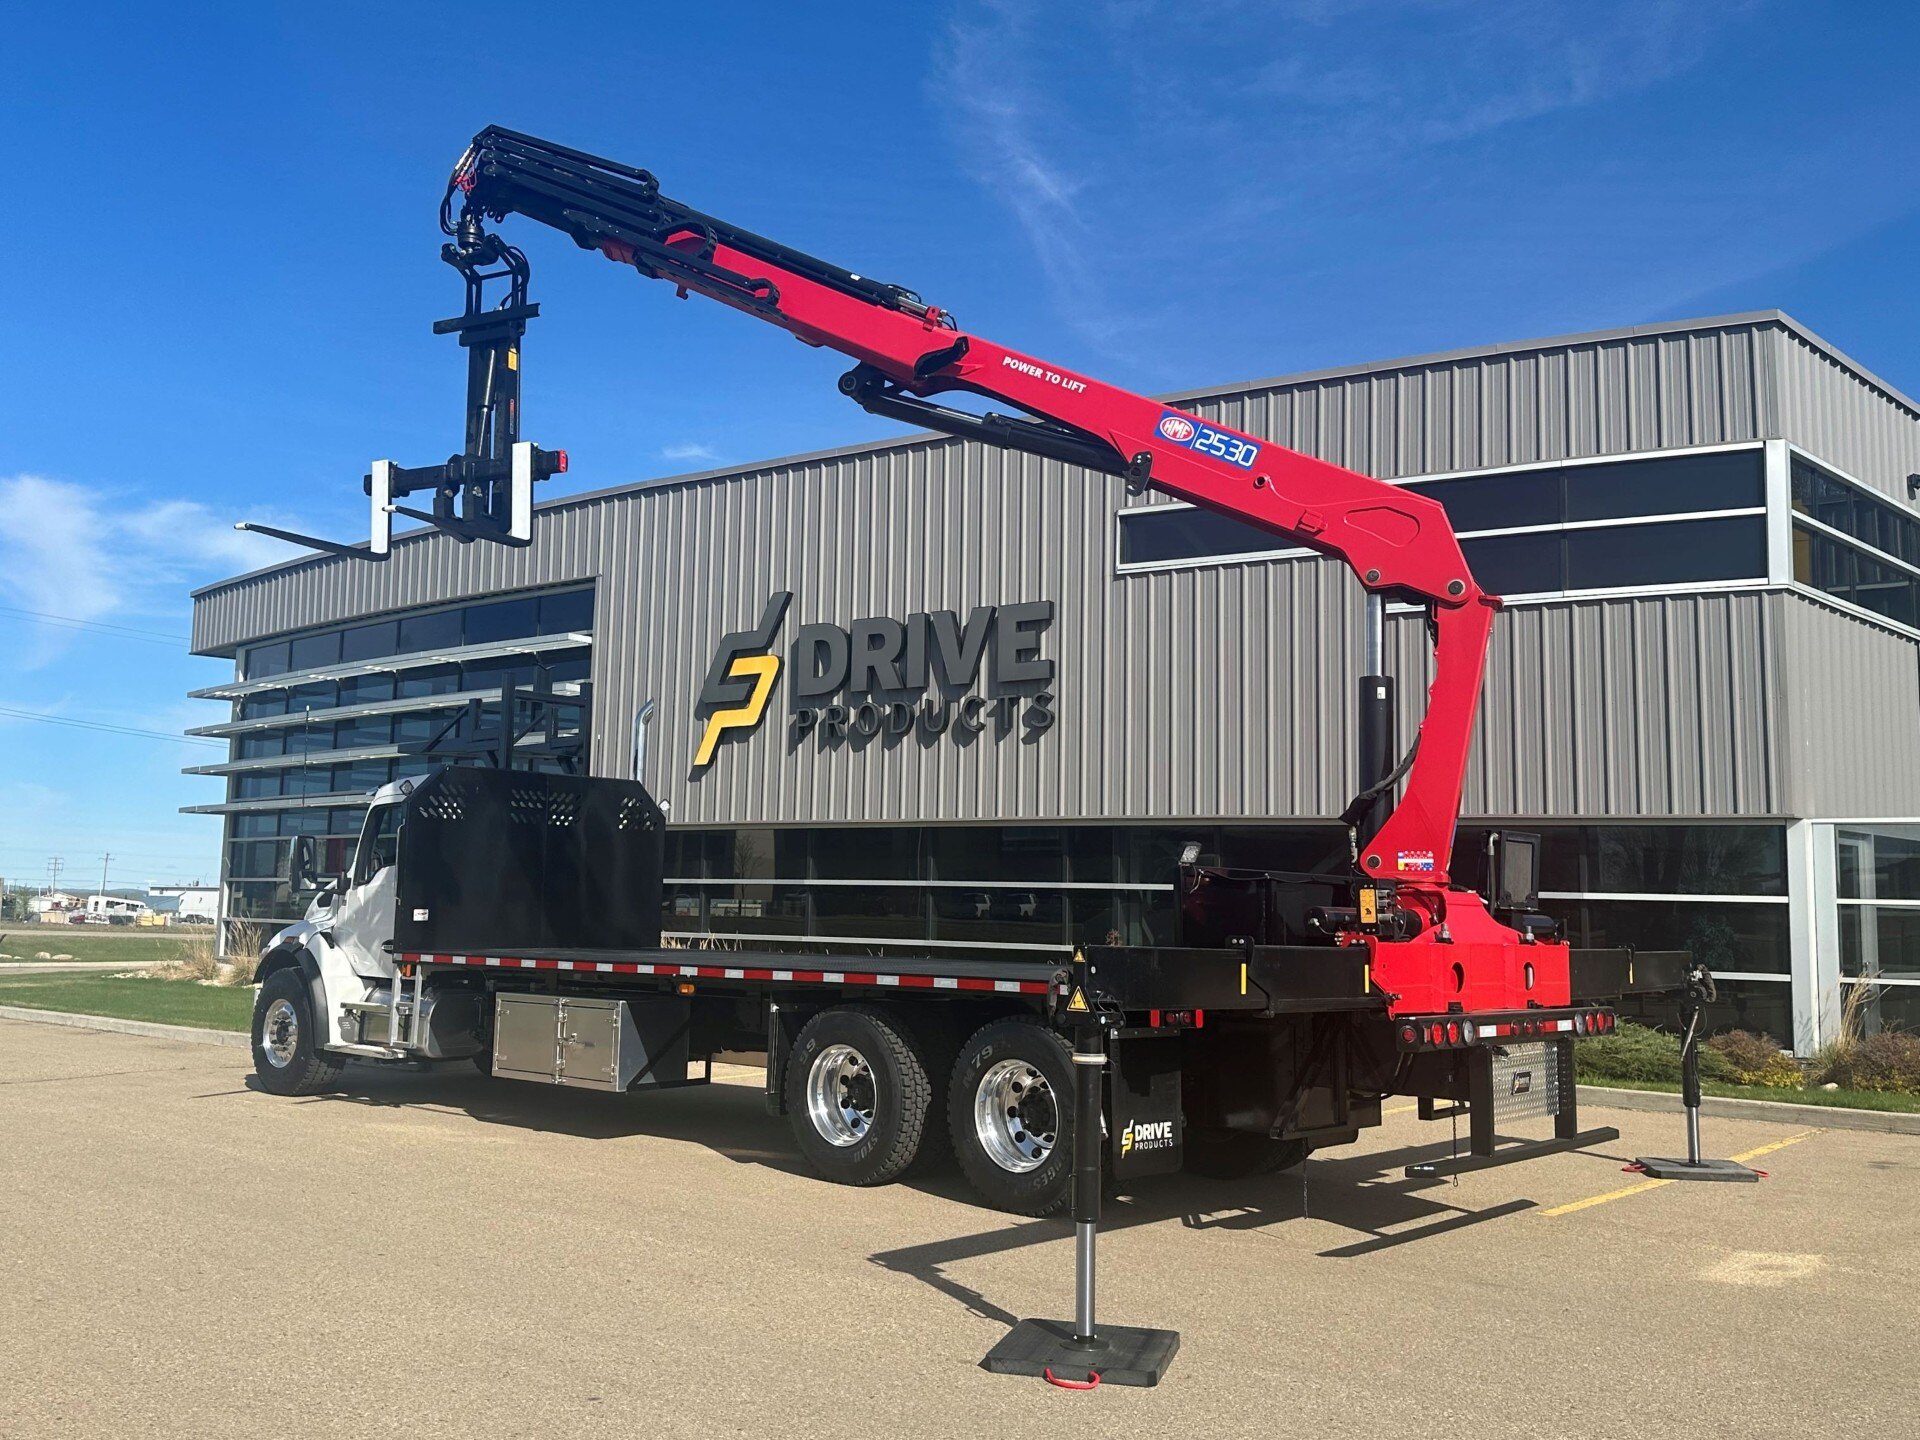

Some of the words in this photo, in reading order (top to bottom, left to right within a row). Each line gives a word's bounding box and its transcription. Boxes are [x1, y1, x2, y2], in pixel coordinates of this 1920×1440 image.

[1002, 356, 1044, 378] POWER
[1045, 371, 1061, 384] TO
[1061, 378, 1087, 394] LIFT
[1163, 419, 1190, 439] HMF
[1194, 428, 1258, 467] 2530
[796, 600, 1055, 697] DRIVE
[795, 691, 1055, 740] PRODUCTS
[1134, 1121, 1173, 1142] DRIVE
[1134, 1138, 1174, 1151] PRODUCTS
